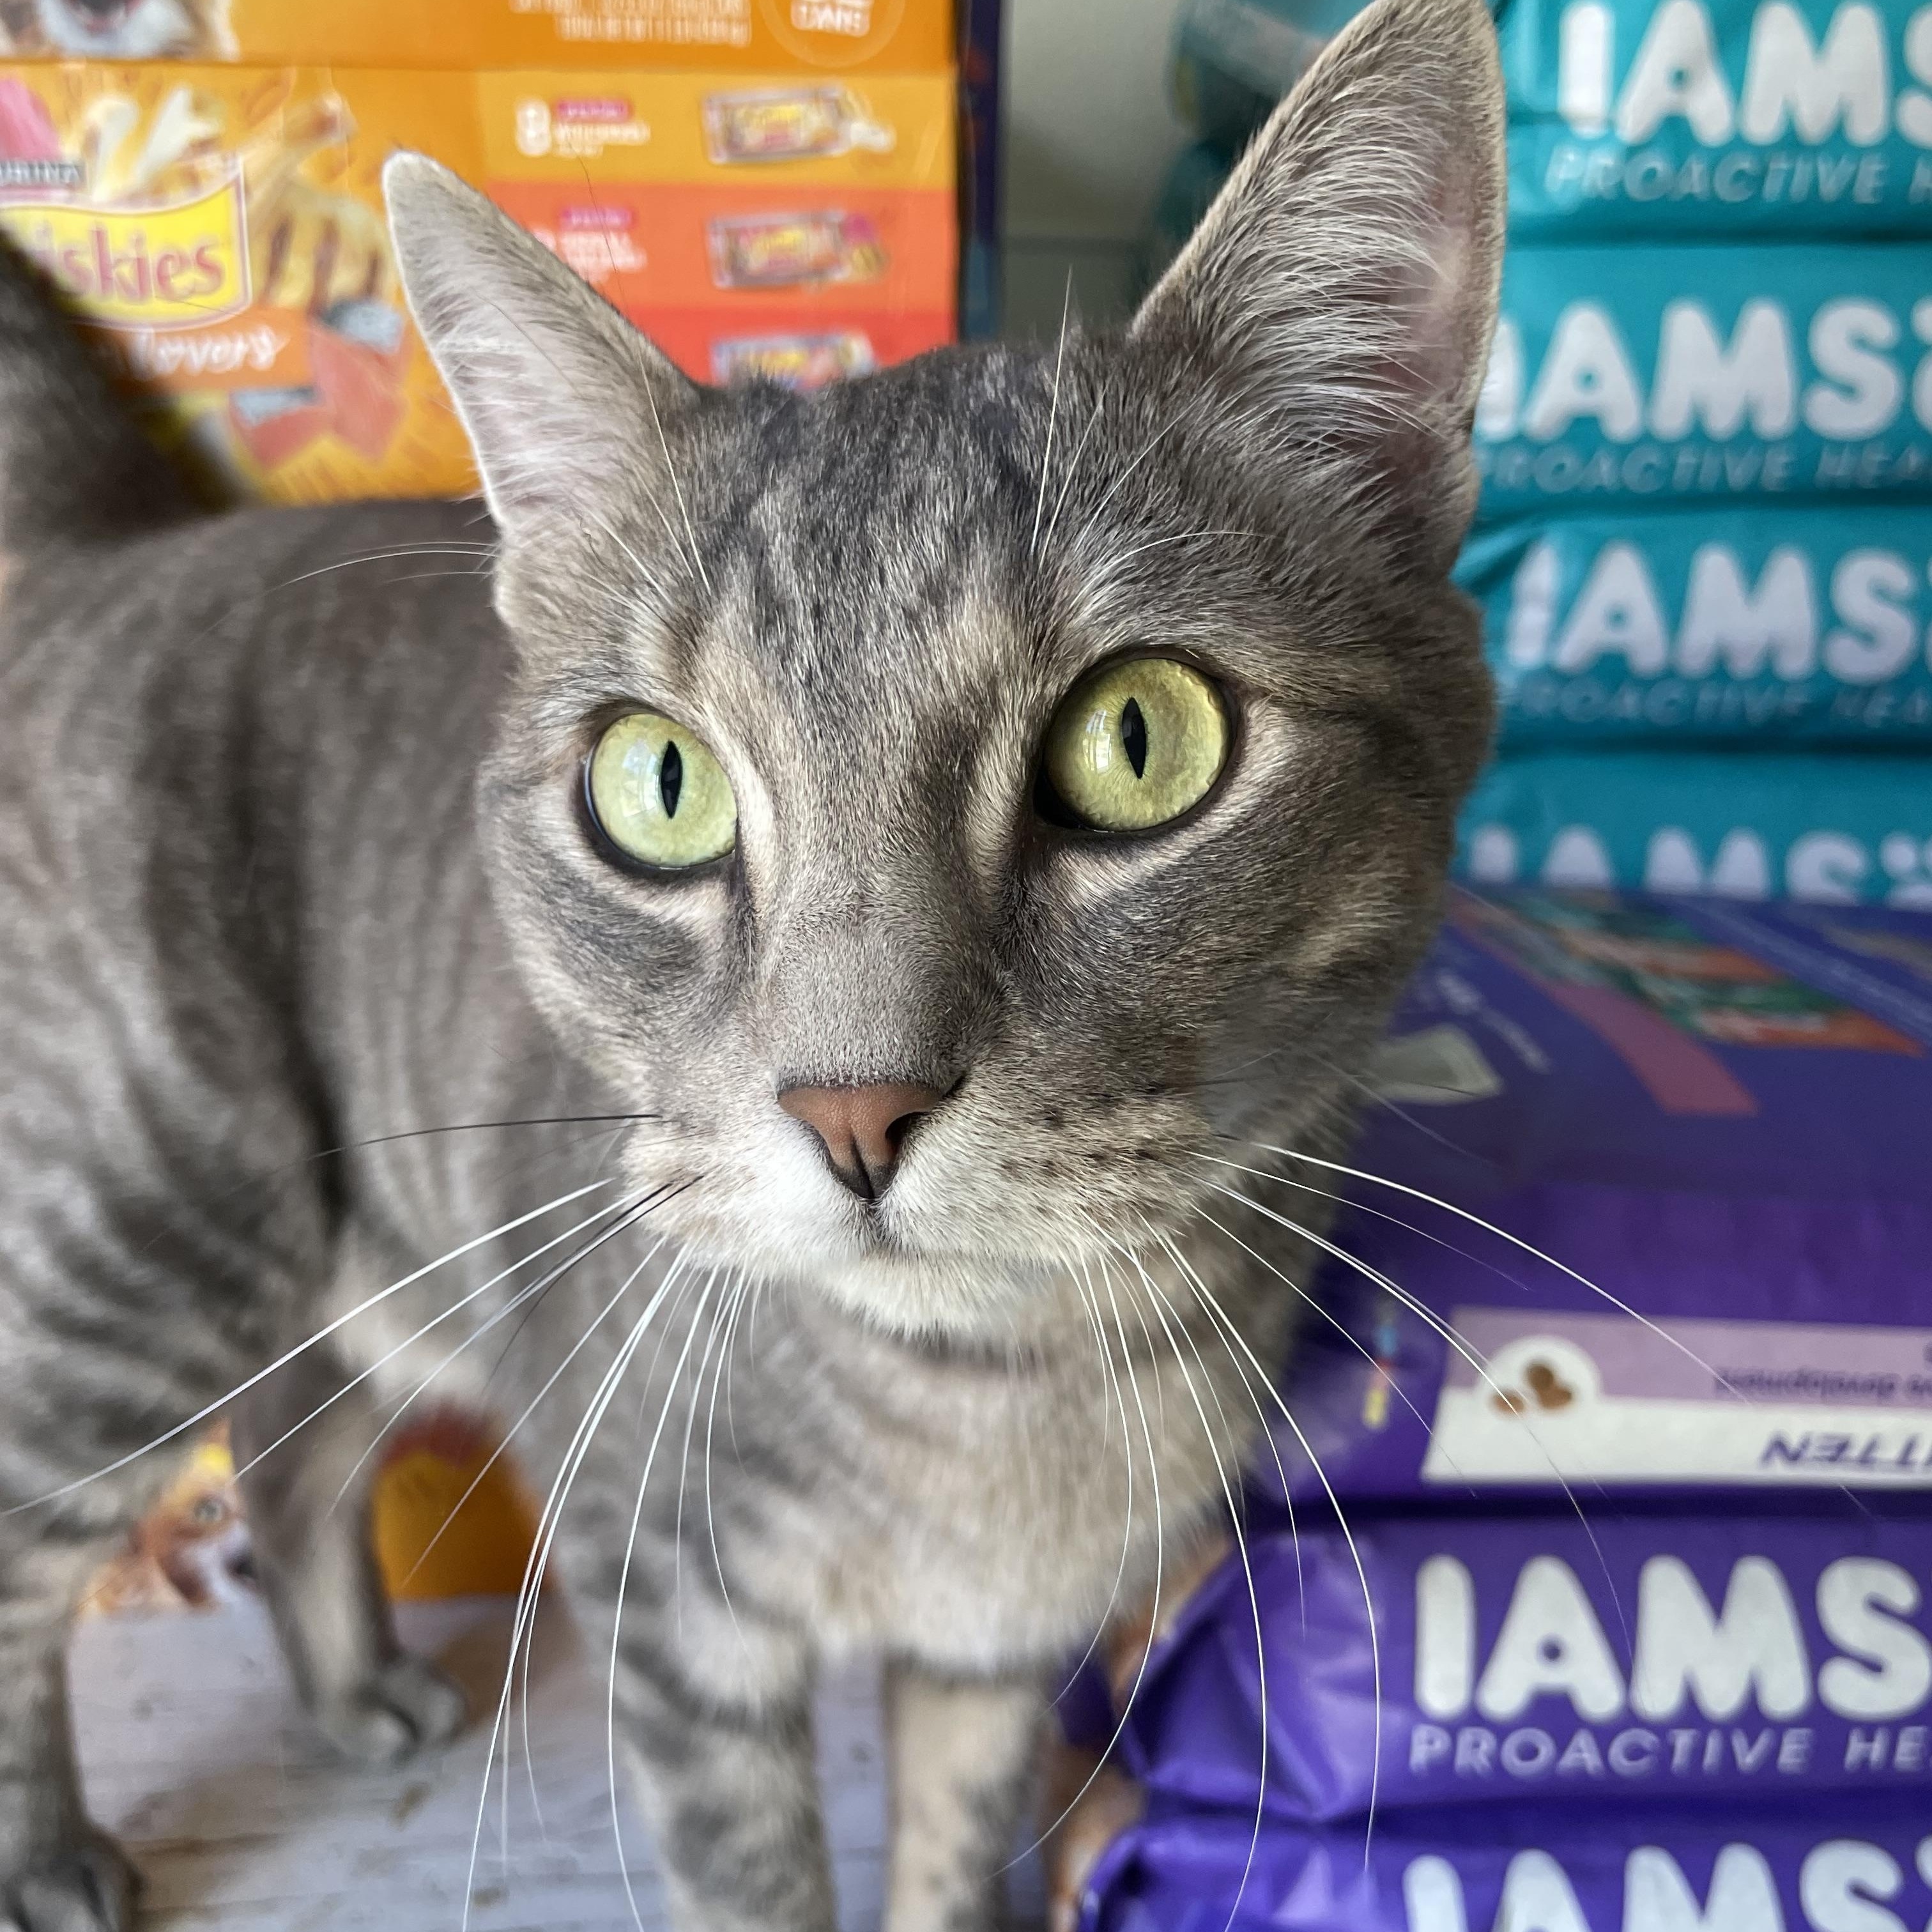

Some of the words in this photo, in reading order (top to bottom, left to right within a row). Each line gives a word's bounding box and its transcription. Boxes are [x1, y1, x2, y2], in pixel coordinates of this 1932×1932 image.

[1545, 144, 1885, 204] PROACTIVE
[1471, 296, 1903, 444] IAMS
[1506, 538, 1917, 686] IAMS
[1413, 1554, 1932, 1722] IAMS
[1409, 1725, 1813, 1779] PROACTIVE
[1845, 1725, 1932, 1775] HE
